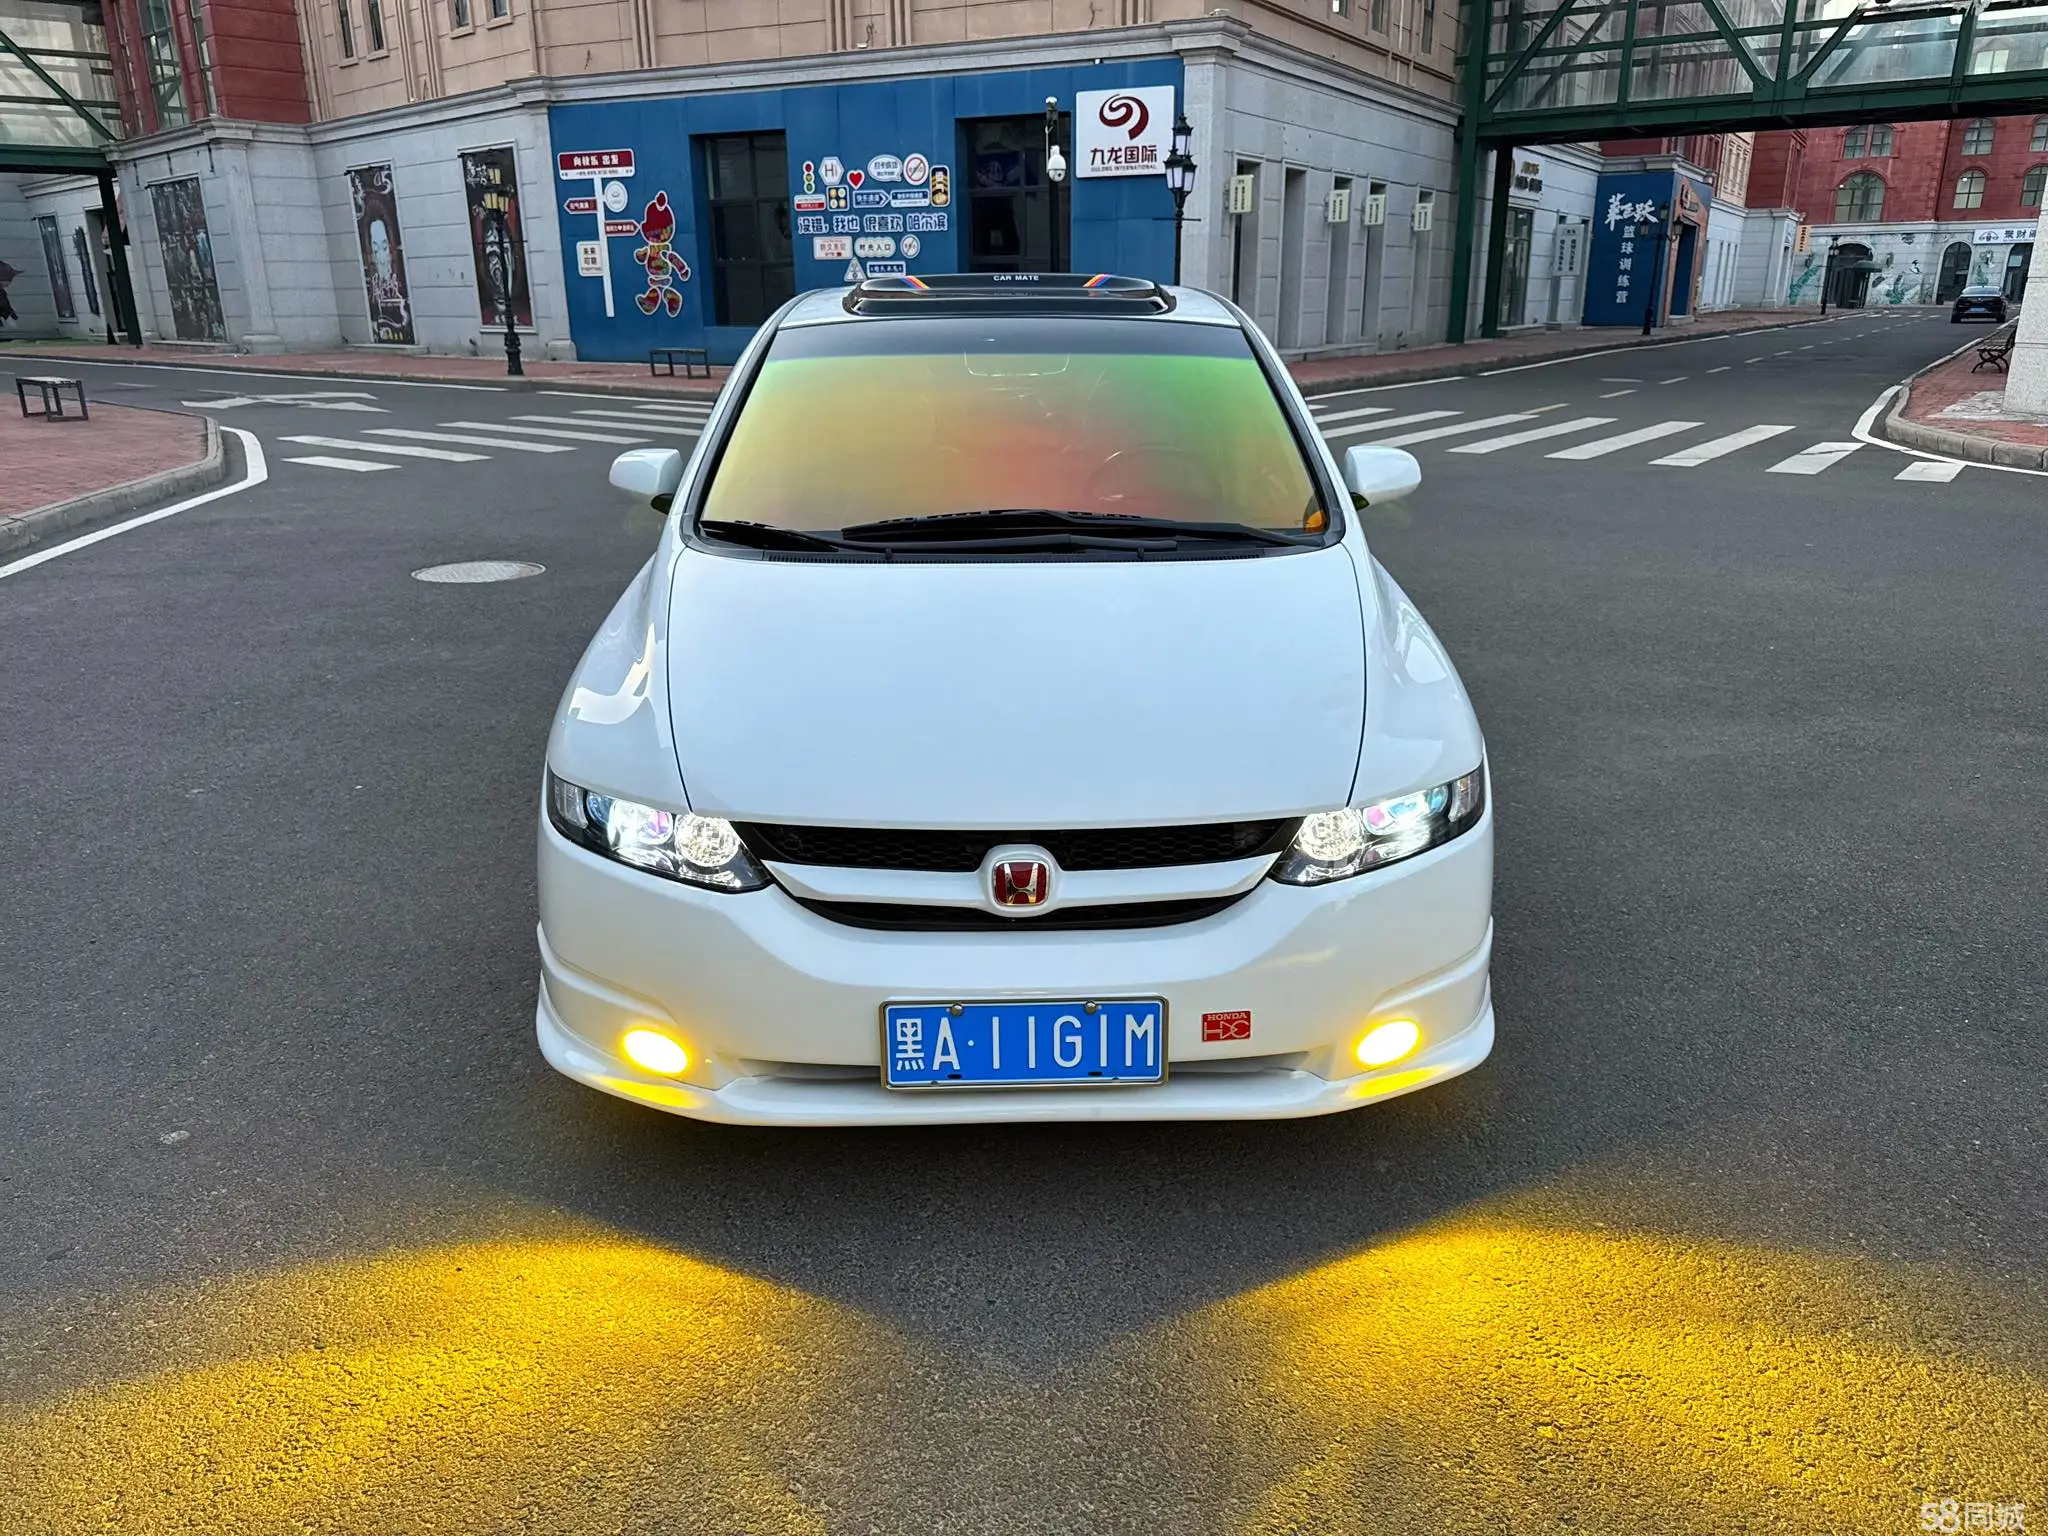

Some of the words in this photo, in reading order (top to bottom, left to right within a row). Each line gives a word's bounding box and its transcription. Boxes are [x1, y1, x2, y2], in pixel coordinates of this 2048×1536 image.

[602, 154, 619, 165] 出发
[1090, 145, 1158, 166] 九龙国际
[824, 164, 838, 178] Hi
[1114, 164, 1158, 172] INTERNATIONAL
[833, 215, 861, 233] 我也
[863, 214, 904, 233] 很喜欢
[907, 212, 948, 232] 哈尔滨
[1615, 225, 1636, 304] 篮球训练营
[1207, 1012, 1248, 1021] HONDA
